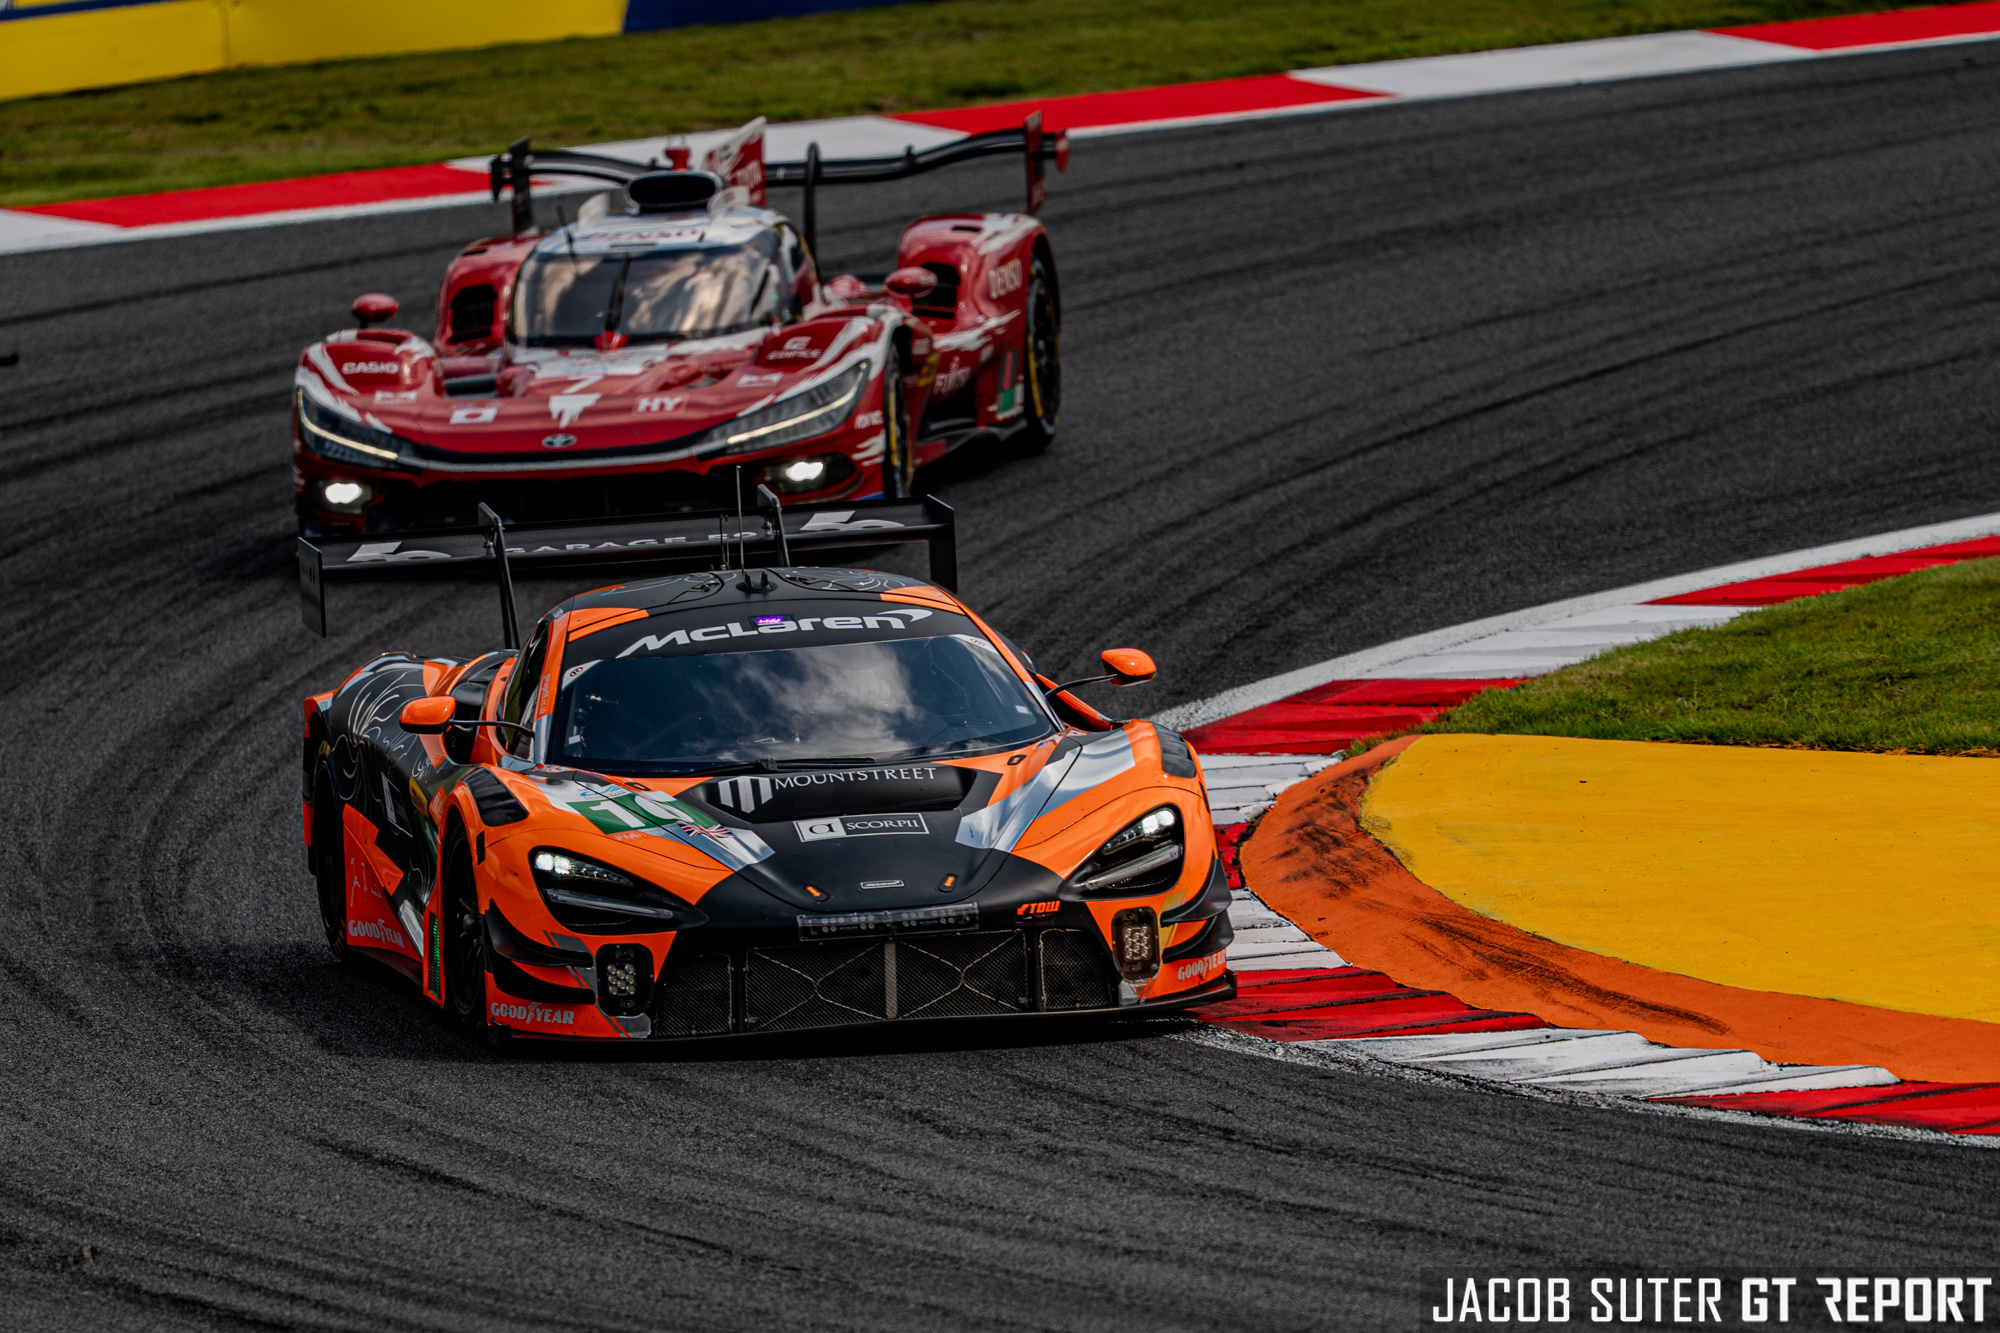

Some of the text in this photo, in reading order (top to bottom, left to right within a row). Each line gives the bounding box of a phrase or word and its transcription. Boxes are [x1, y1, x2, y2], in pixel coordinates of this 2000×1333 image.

[988, 257, 1022, 299] DENSO
[342, 361, 399, 375] CASIO
[636, 396, 683, 412] HY
[615, 613, 908, 659] McLaren
[775, 767, 937, 790] MOUNTSTREET
[589, 795, 695, 829] 10
[846, 818, 920, 832] SCORPII
[1029, 900, 1061, 914] TOW
[349, 919, 405, 948] GOODYEAR
[490, 1002, 575, 1025] GOODYEAR
